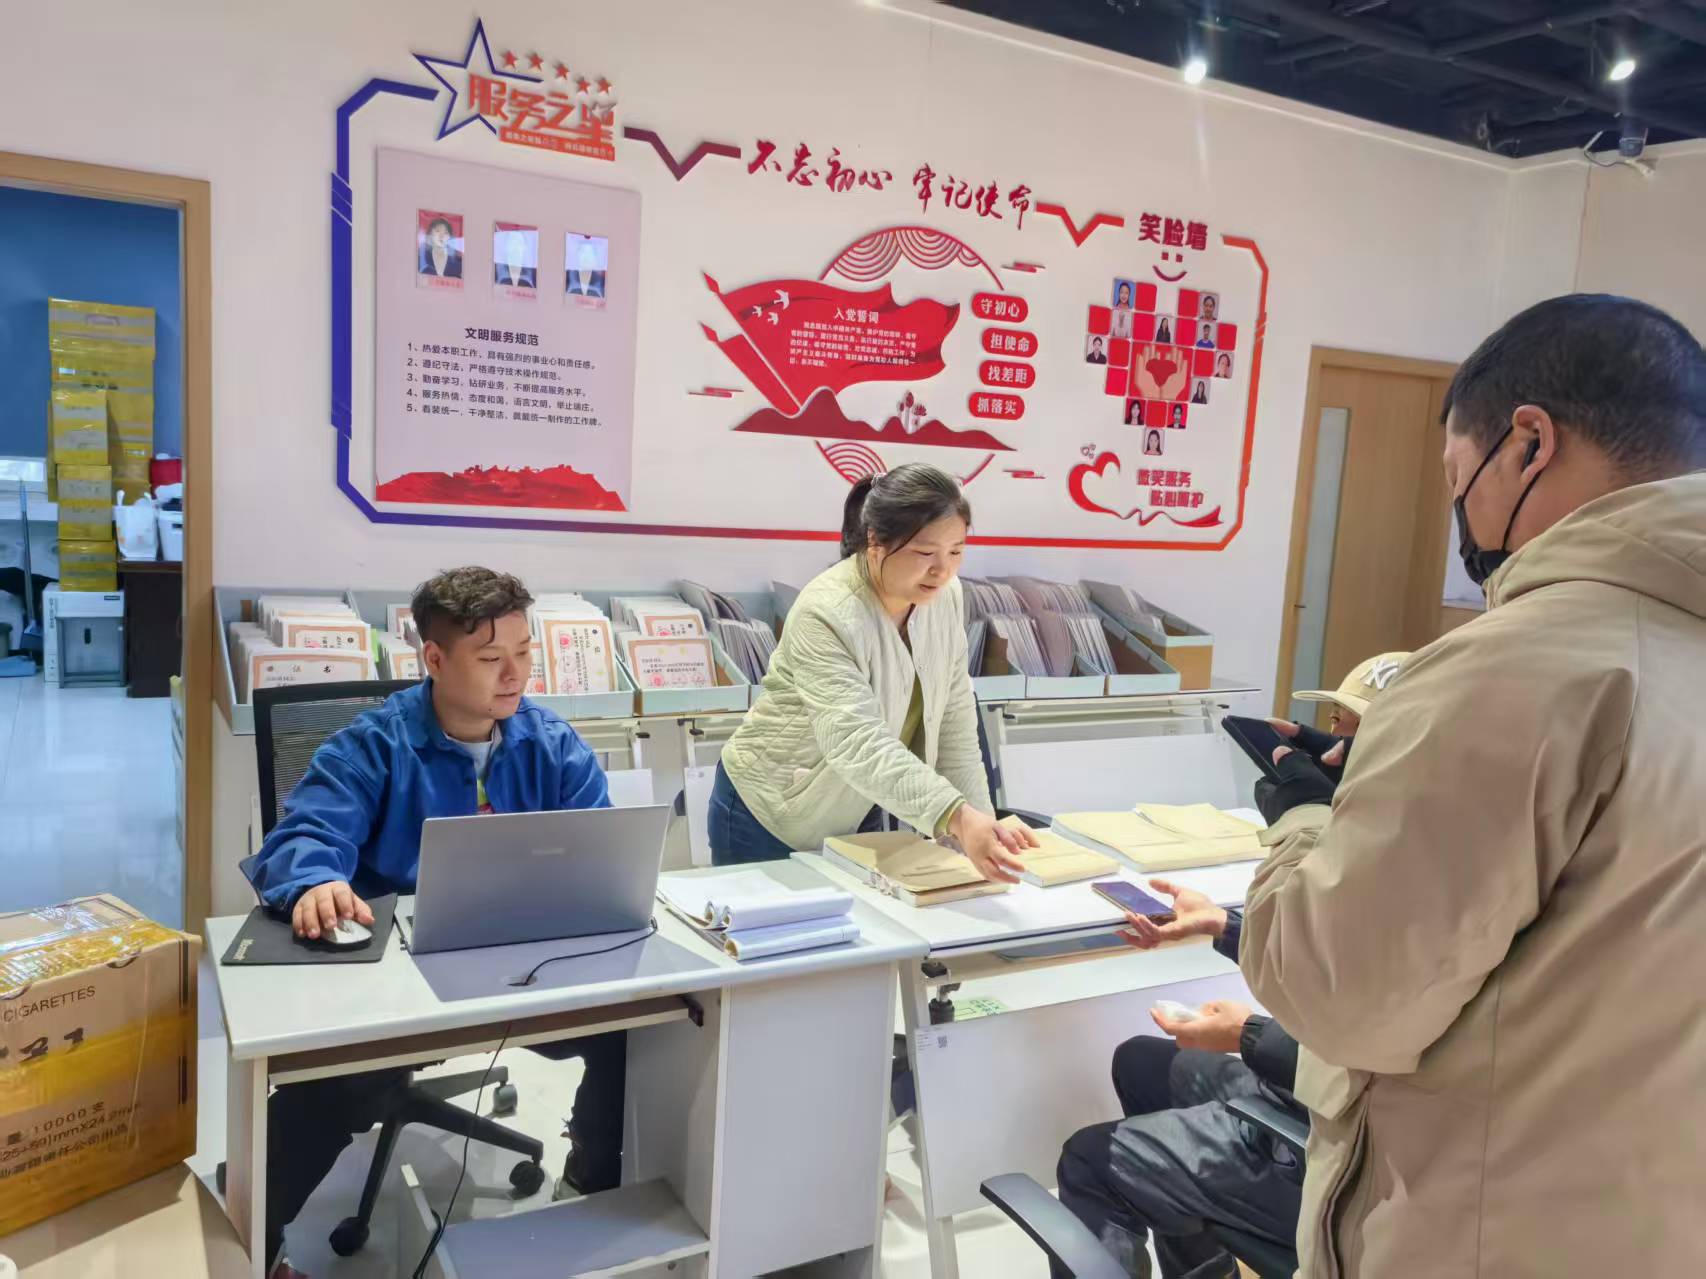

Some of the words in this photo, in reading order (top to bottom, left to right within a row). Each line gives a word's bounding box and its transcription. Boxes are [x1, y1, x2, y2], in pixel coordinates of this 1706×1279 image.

[469, 73, 614, 146] 服务之星
[747, 139, 893, 192] 不忘初心
[912, 163, 1032, 230] 牢记使命
[1138, 212, 1208, 251] 笑脸墙
[834, 307, 880, 324] 入党誓词
[980, 298, 1020, 318] 守初心
[464, 327, 539, 346] 文明服务规范
[990, 332, 1030, 352] 担使命
[988, 365, 1028, 384] 找差距
[977, 396, 1017, 415] 抓落实
[4, 986, 96, 1022] CIGARETTES
